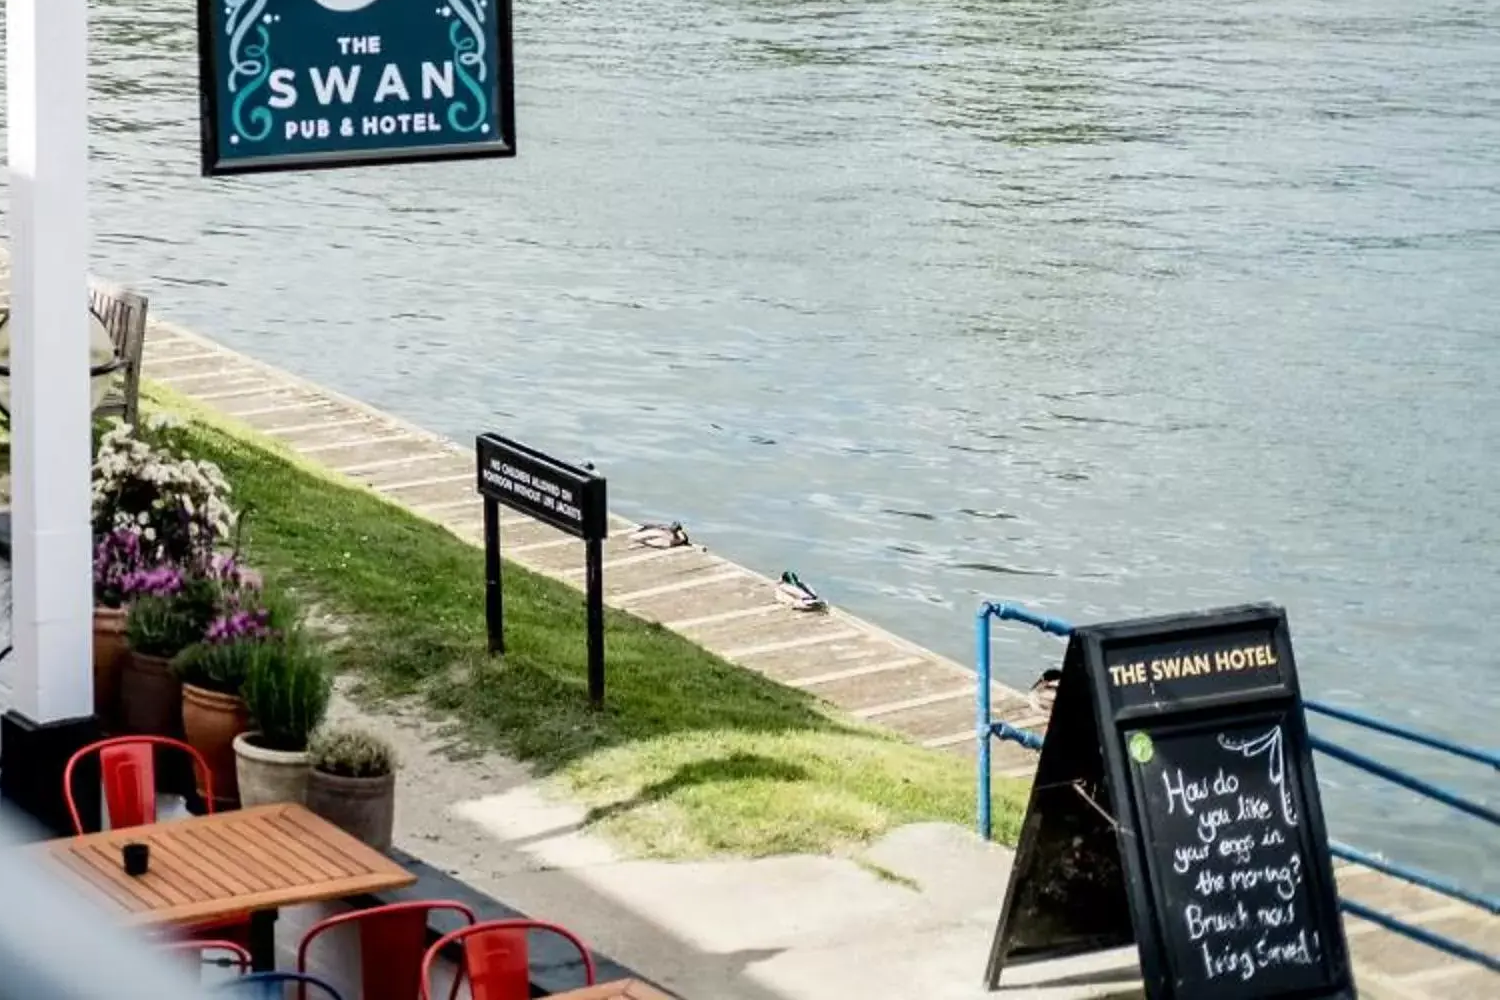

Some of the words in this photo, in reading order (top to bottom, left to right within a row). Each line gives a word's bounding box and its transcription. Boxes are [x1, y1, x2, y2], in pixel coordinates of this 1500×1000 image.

[337, 36, 381, 55] THE
[268, 60, 455, 109] SWAN
[284, 119, 330, 140] PUB
[339, 116, 355, 137] &
[362, 113, 441, 136] HOTEL
[1108, 663, 1148, 687] THE
[1151, 652, 1211, 681] SWAN
[1214, 645, 1277, 672] HOTEL
[1161, 767, 1209, 815] How
[1213, 767, 1239, 796] do
[1197, 808, 1232, 843] you
[1236, 794, 1273, 821] like
[1260, 826, 1286, 846] in
[1194, 869, 1225, 895] the
